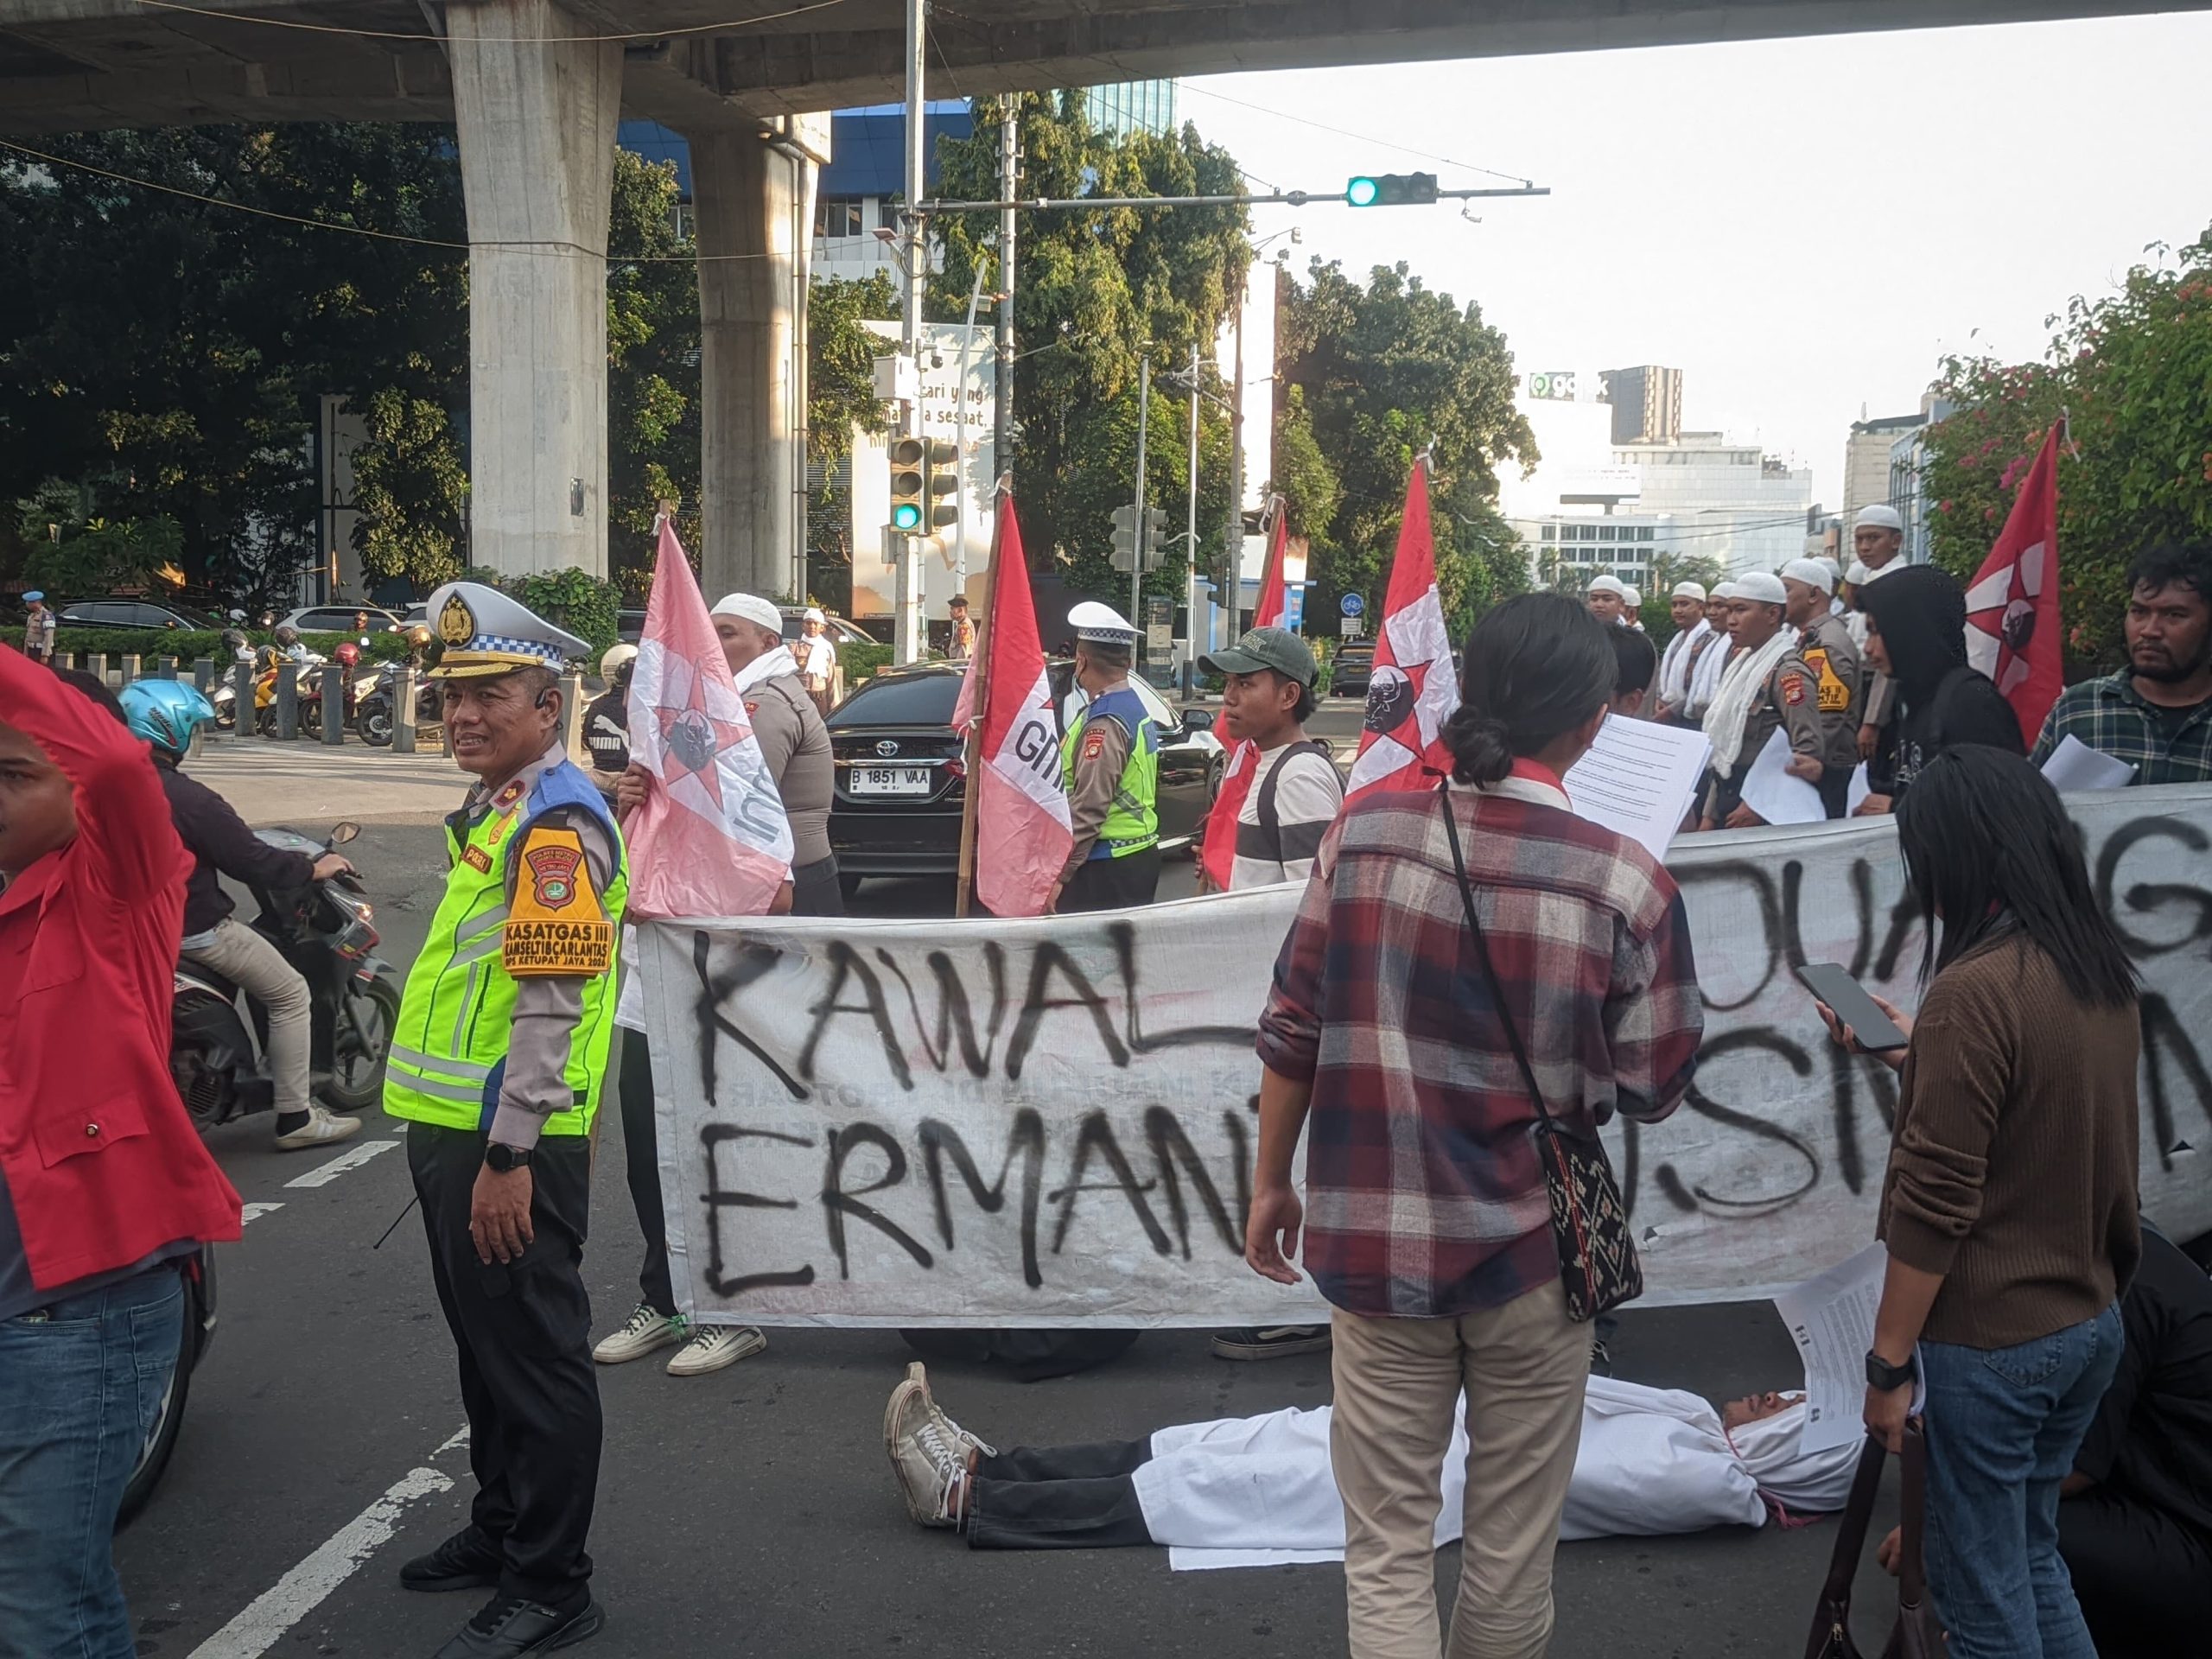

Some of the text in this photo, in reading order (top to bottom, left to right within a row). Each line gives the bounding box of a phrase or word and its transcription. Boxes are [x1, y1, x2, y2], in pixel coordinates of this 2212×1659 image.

[951, 386, 983, 405] yng
[1553, 376, 1608, 397] gok
[852, 770, 928, 784] B 1851 VAA
[505, 923, 608, 942] KASATGAS III
[518, 956, 560, 965] KETUPAT
[563, 956, 586, 966] JAYA
[694, 919, 1259, 1107] KAWAL
[698, 1103, 1259, 1295] ERMAN
